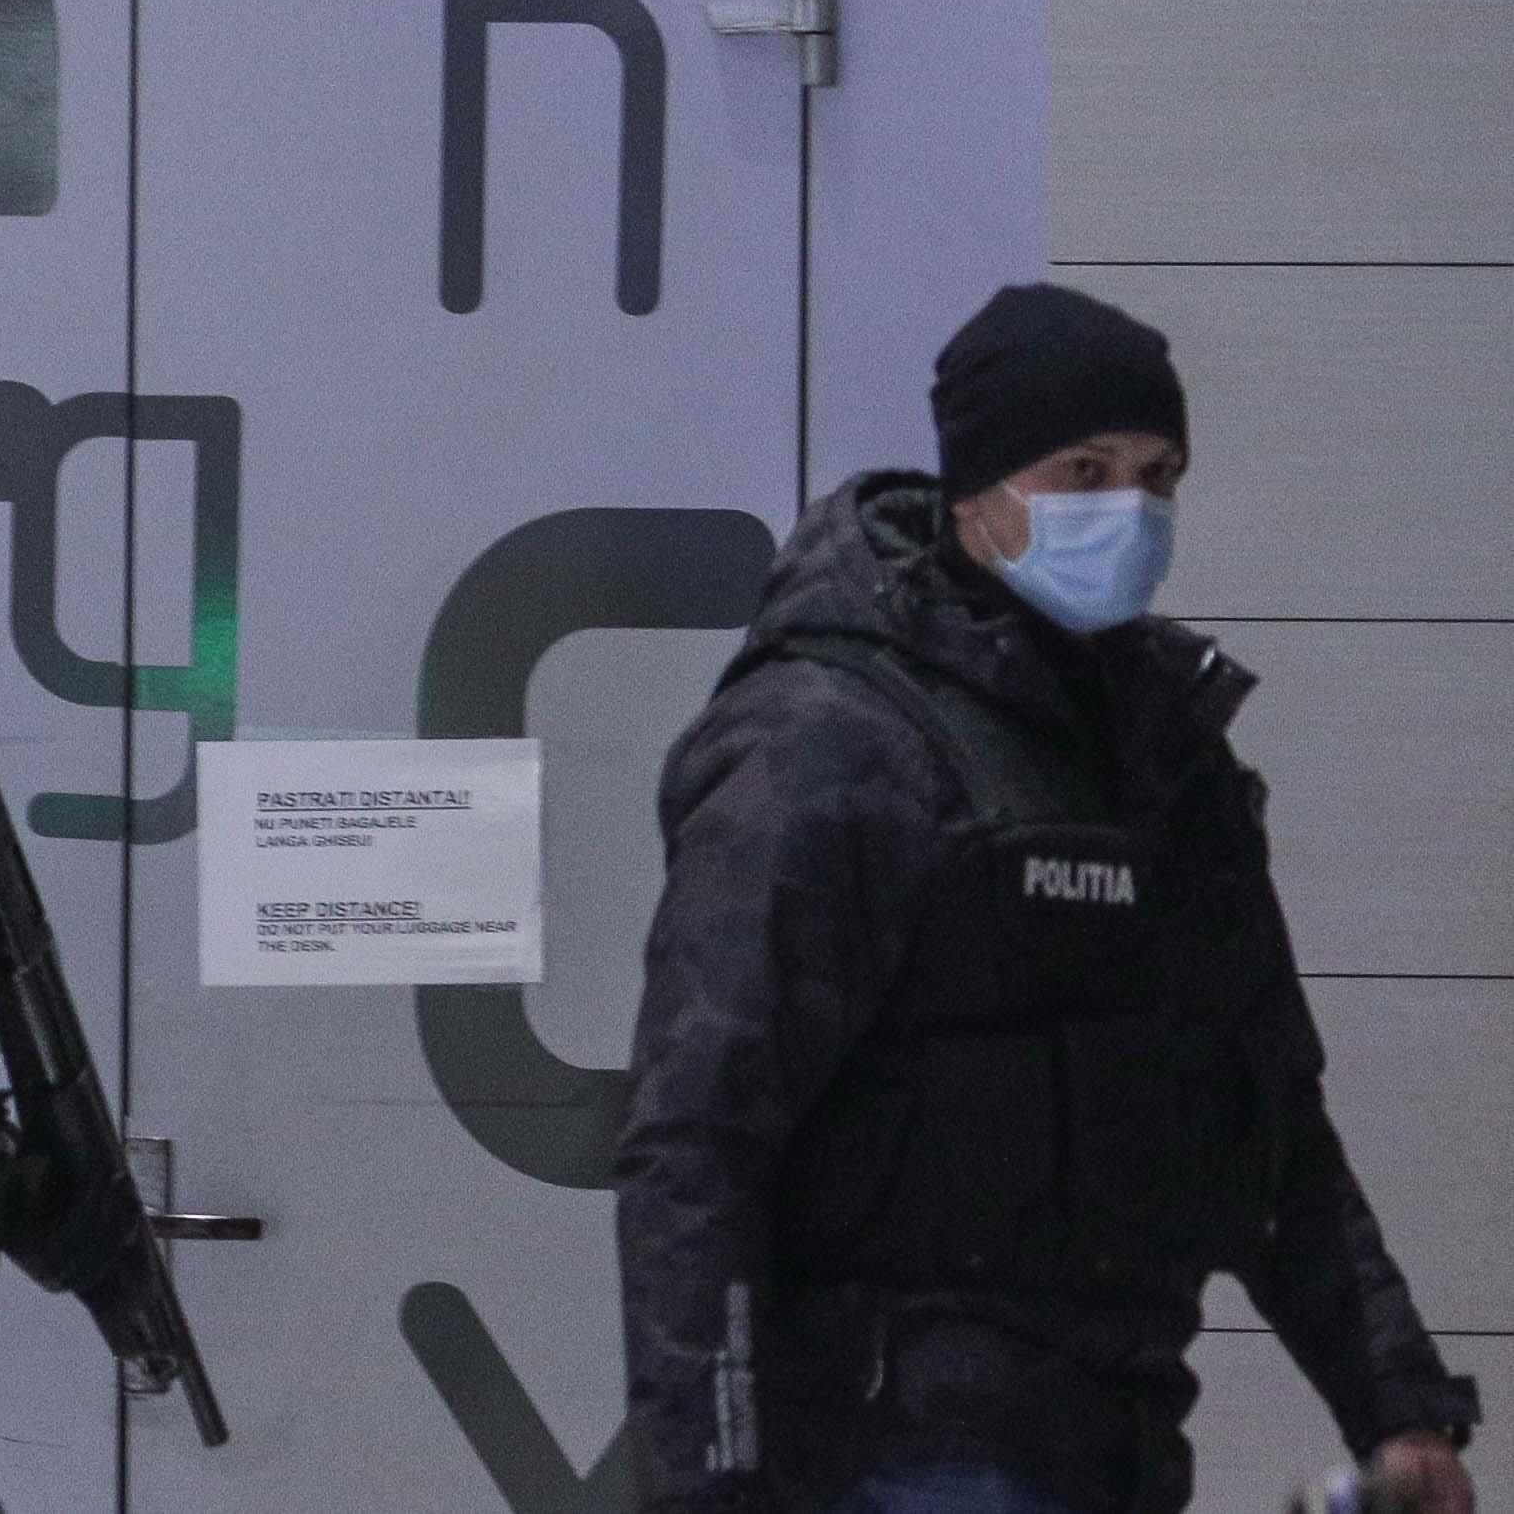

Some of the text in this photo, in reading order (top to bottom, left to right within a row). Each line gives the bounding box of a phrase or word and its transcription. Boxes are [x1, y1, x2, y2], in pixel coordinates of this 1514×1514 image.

[1023, 855, 1136, 905] POLITIA
[256, 901, 311, 918] KEEP
[284, 923, 313, 936] NOT
[398, 921, 471, 934] LUGGAGE
[475, 920, 518, 934] NEAR
